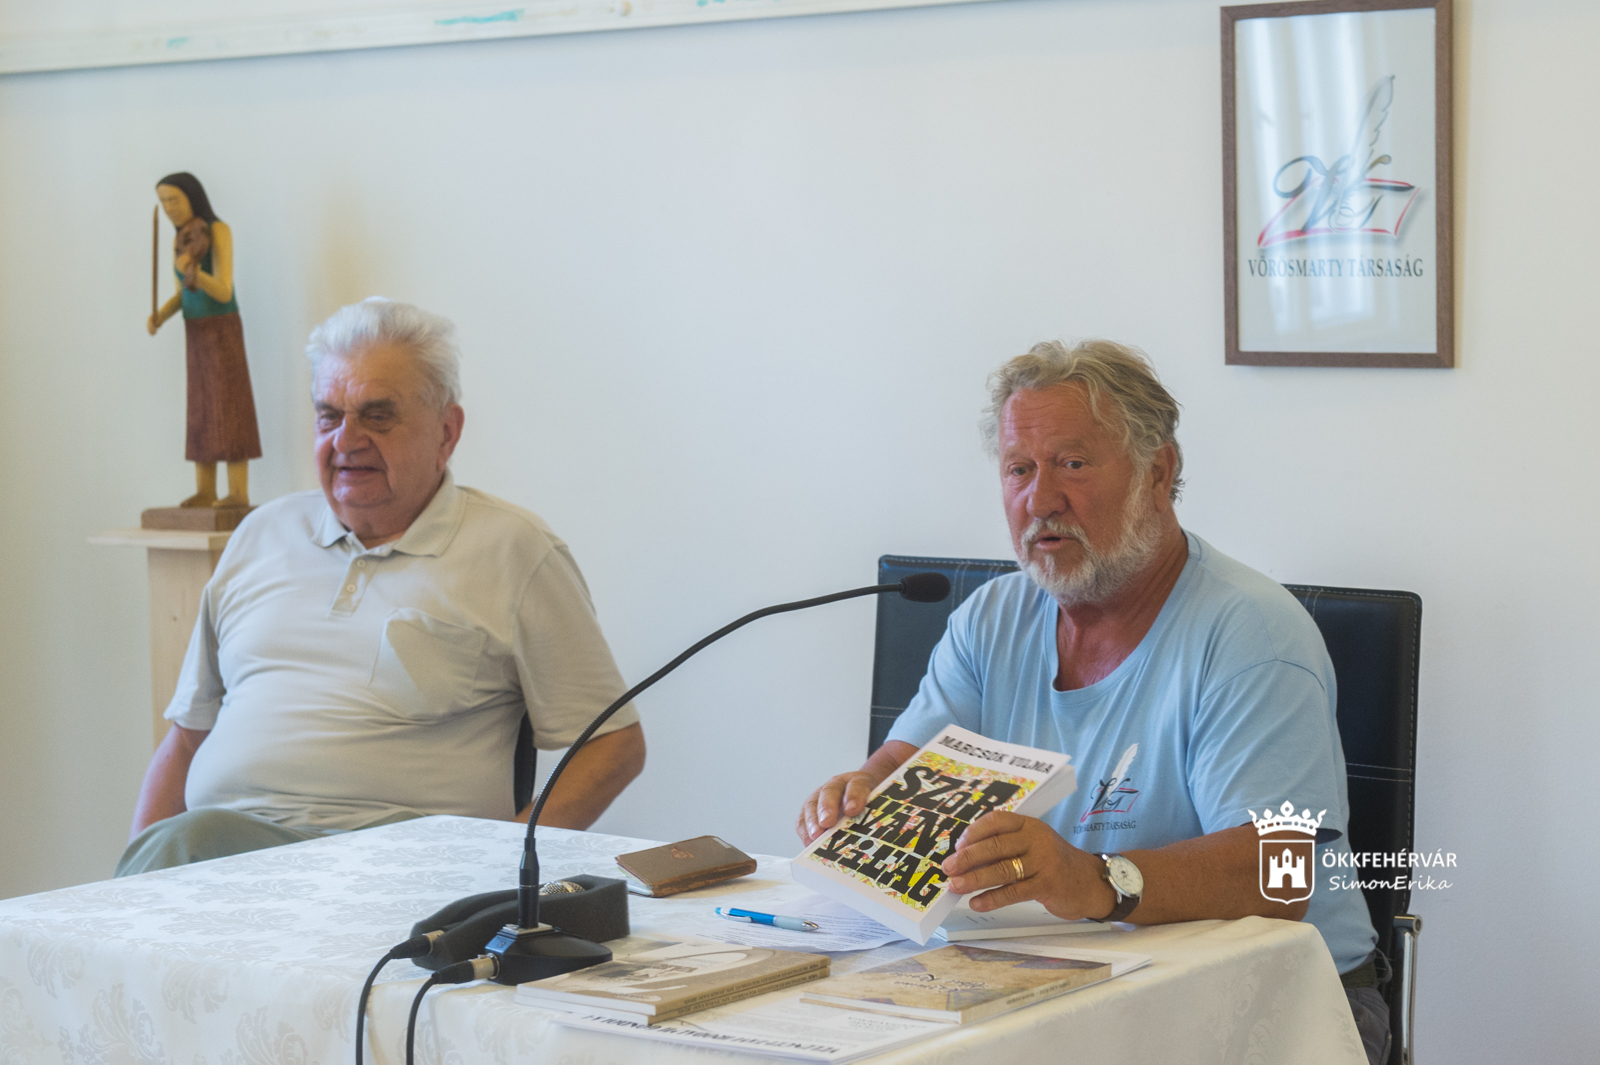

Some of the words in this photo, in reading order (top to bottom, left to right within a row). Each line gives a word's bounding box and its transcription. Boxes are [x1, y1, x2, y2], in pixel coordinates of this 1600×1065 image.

[1248, 254, 1345, 278] VÖRÖSMARTY
[1348, 253, 1424, 278] TÁRSASÁG
[880, 765, 1021, 824] SZÓR
